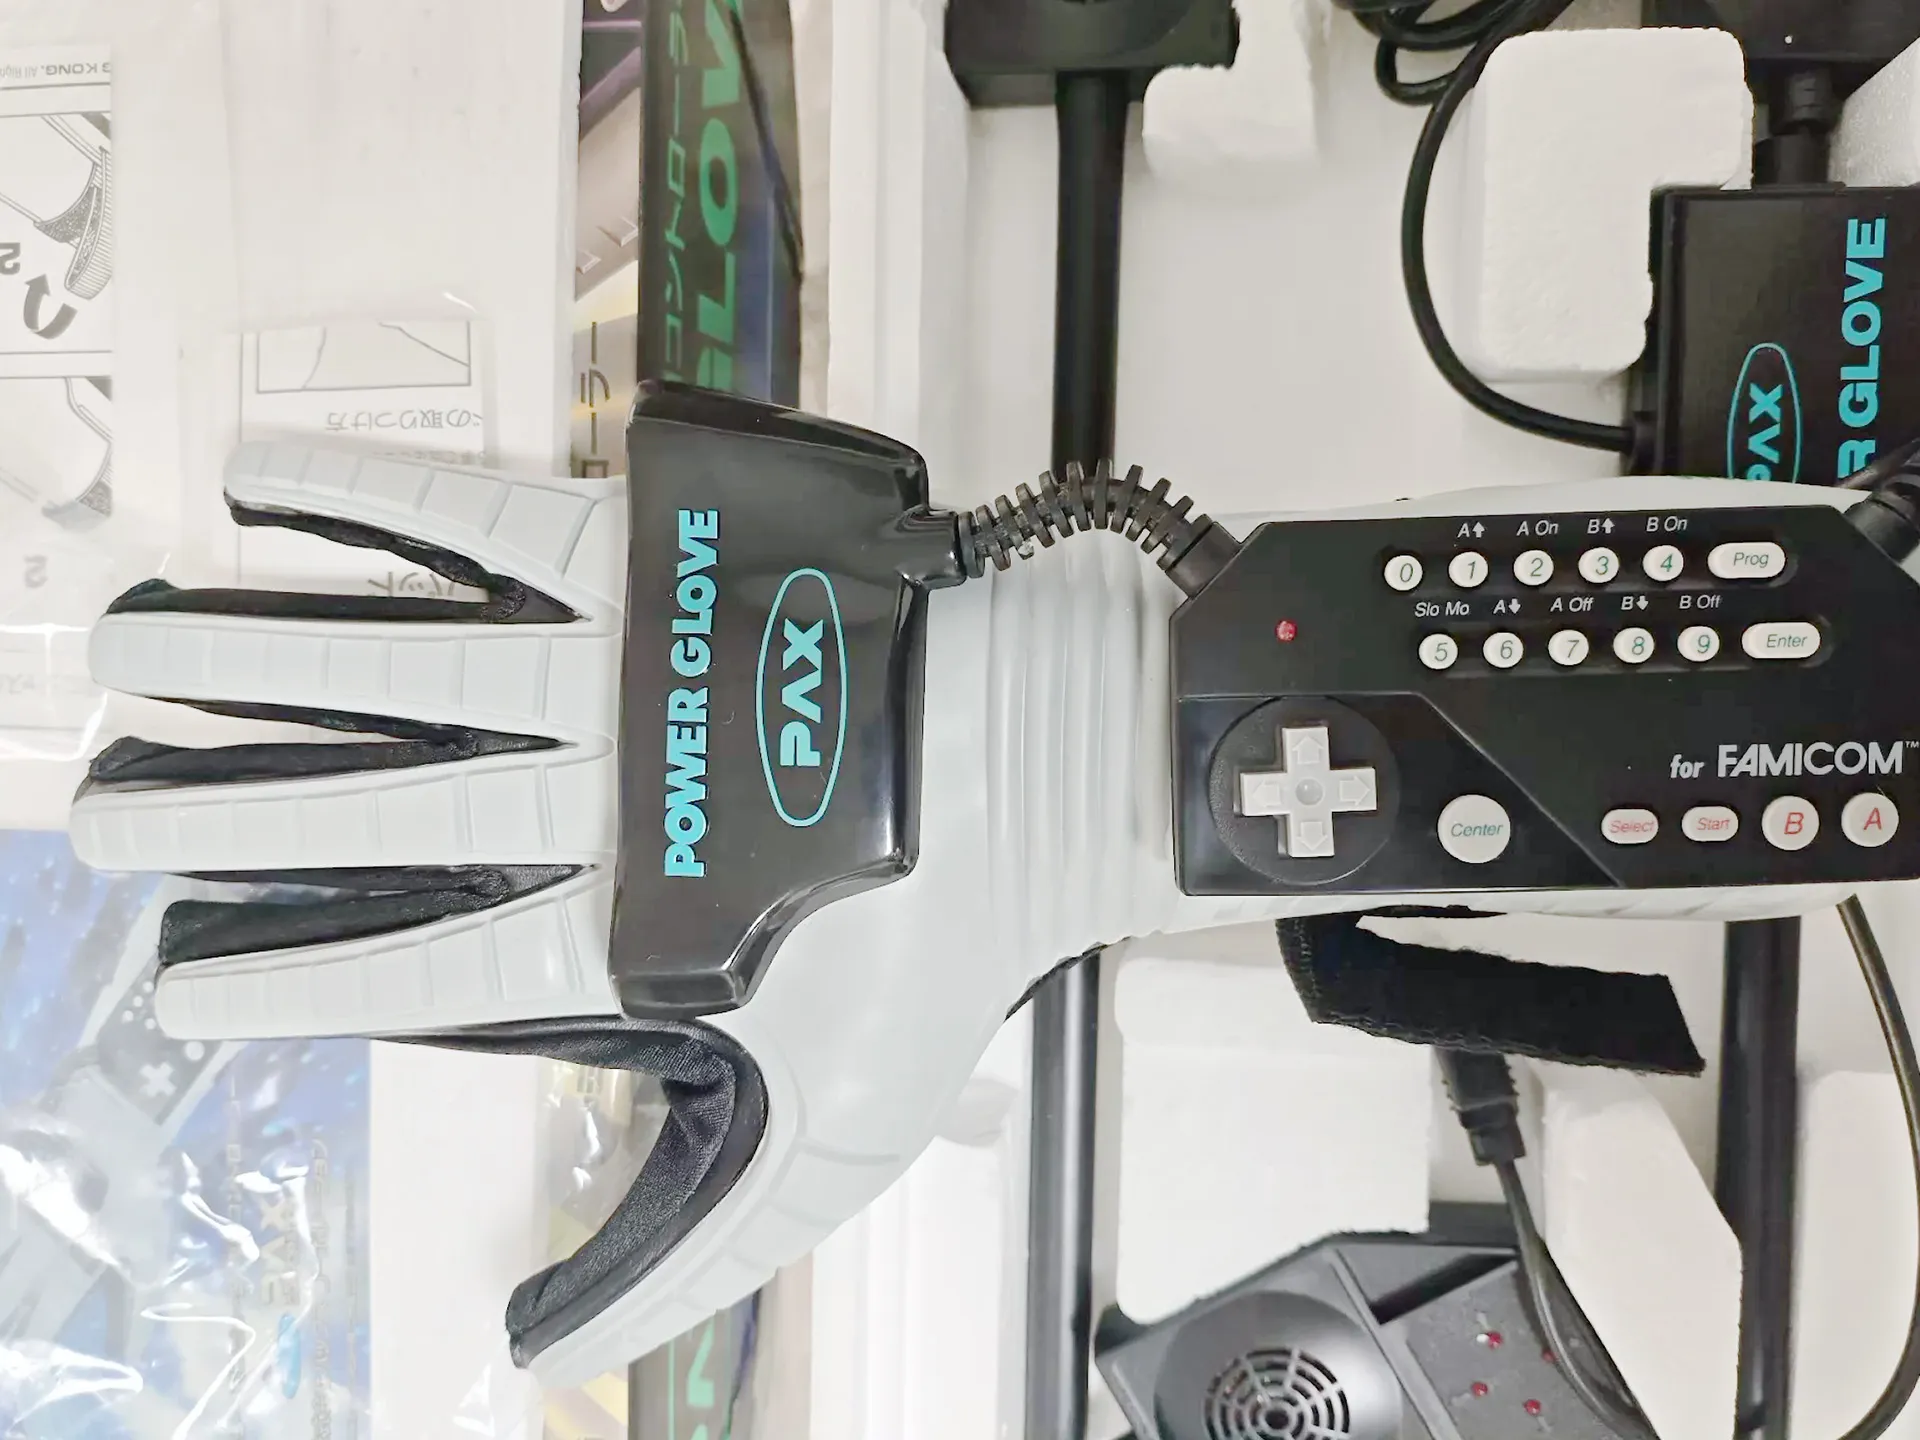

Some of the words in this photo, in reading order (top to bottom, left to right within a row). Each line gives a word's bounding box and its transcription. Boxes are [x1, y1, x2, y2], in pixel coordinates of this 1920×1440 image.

[41, 62, 98, 77] KONG.
[1837, 217, 1887, 429] GLOVE
[1457, 522, 1470, 538] A
[1516, 520, 1529, 536] A
[1535, 519, 1559, 536] On
[1587, 519, 1600, 534] B
[1646, 516, 1659, 532] B
[1663, 515, 1688, 532] On
[1467, 560, 1476, 580] 1
[1530, 557, 1544, 577] 2
[1595, 555, 1609, 576] 3
[1660, 554, 1673, 573] 4
[1733, 552, 1770, 568] Prog
[1399, 562, 1414, 583] 0
[669, 508, 720, 678] GLOVE
[1621, 595, 1634, 611] B
[1679, 595, 1692, 609] B
[1696, 594, 1722, 609] Off
[1415, 602, 1440, 617] Slo
[1445, 601, 1470, 616] Mo
[1493, 599, 1506, 614] A
[1550, 597, 1563, 612] A
[1569, 596, 1594, 612] Off
[1500, 639, 1514, 660] 6
[1567, 639, 1580, 659] 7
[1631, 636, 1645, 656] 8
[1697, 634, 1710, 654] 9
[1766, 633, 1808, 649] Enter
[1434, 642, 1448, 662] 5
[779, 617, 824, 767] PAX
[1669, 753, 1705, 779] for
[663, 686, 709, 878] POWER
[1609, 818, 1657, 834] Select
[1697, 816, 1732, 831] Start
[1783, 811, 1805, 836] B
[1863, 807, 1884, 831] A
[1450, 820, 1504, 840] Center
